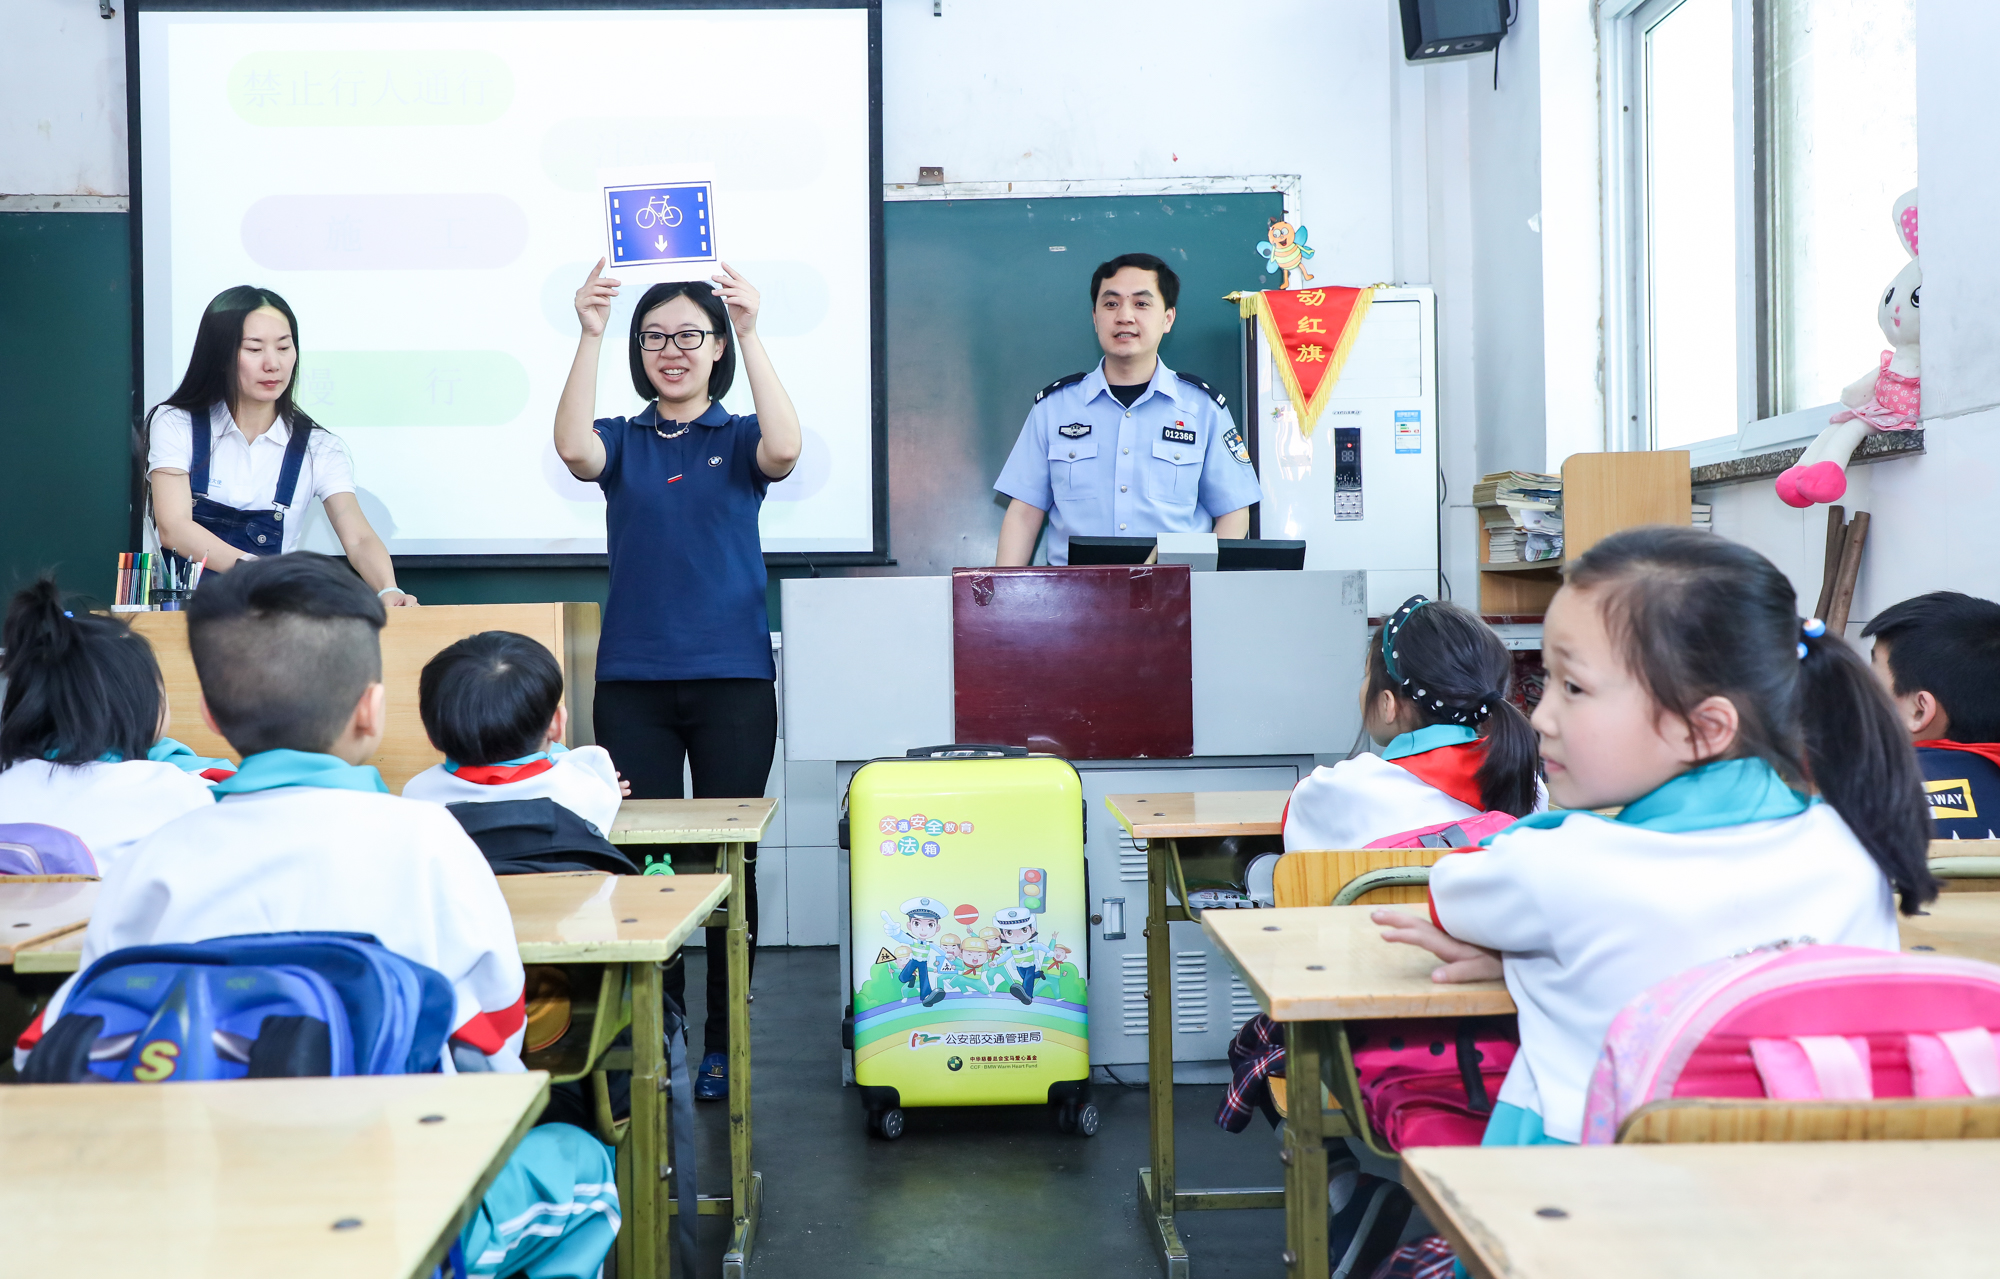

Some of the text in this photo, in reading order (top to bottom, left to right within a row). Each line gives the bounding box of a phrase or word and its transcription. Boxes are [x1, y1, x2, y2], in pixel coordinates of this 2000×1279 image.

[241, 66, 495, 109] 禁止行人通行
[1295, 288, 1327, 363] 动红旗
[1165, 429, 1194, 442] 012366
[881, 814, 973, 834] 交通安全教育
[881, 837, 938, 856] 魔法箱
[945, 1031, 1042, 1045] 公安部交通管理局
[133, 1040, 180, 1082] S
